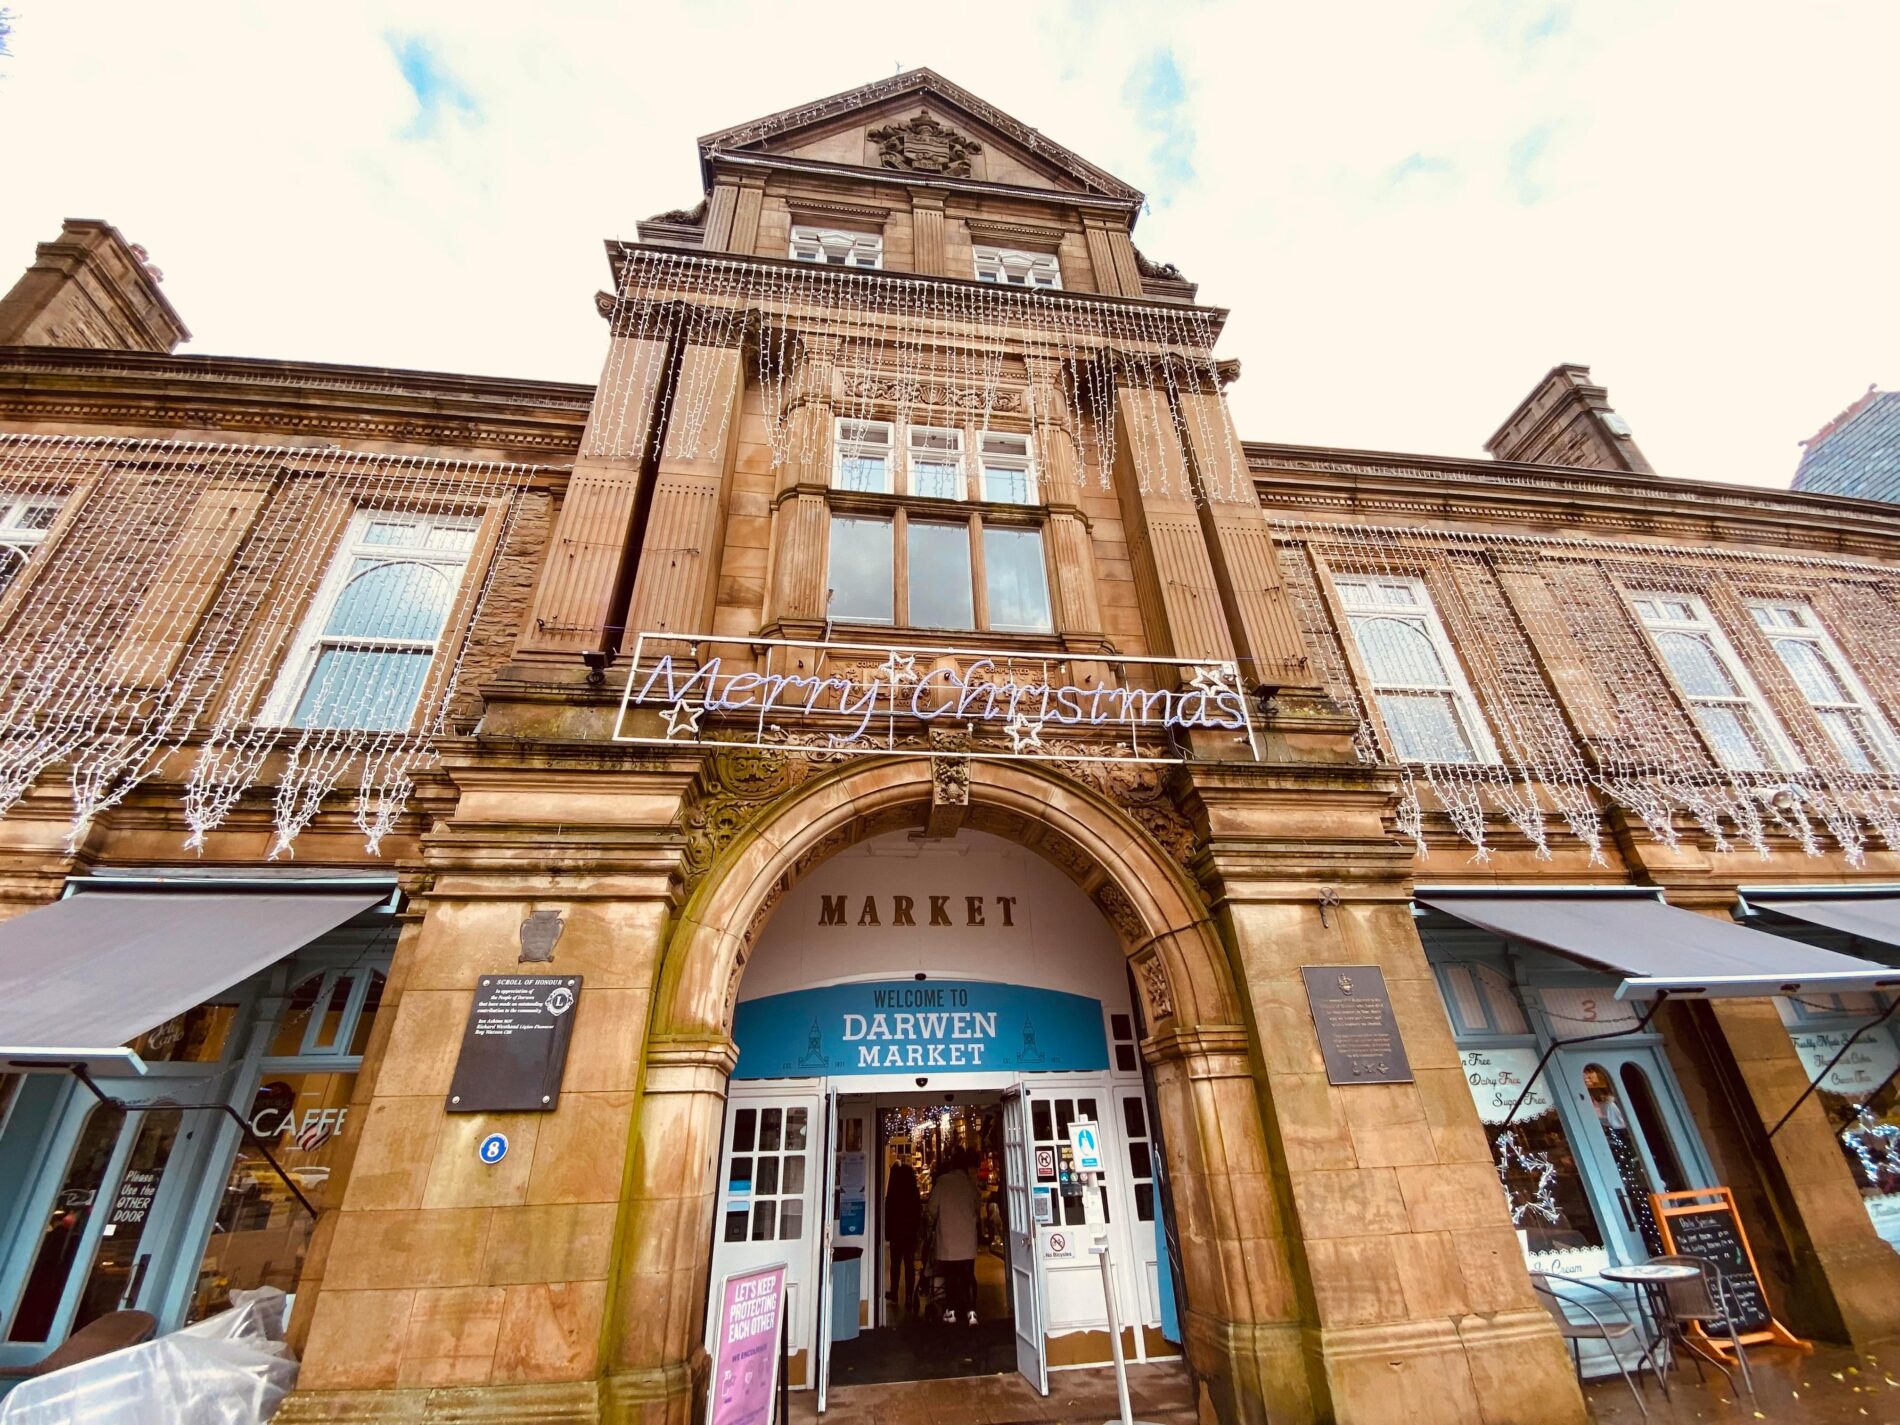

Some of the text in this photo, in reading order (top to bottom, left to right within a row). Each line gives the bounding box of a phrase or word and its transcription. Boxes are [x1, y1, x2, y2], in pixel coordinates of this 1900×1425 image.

[632, 655, 1246, 743] Merry Christmas
[818, 895, 1017, 927] MARKET
[873, 989, 968, 1009] WELCOME TO
[1582, 1000, 1597, 1022] 3
[842, 1012, 997, 1041] DARWEN
[857, 1044, 985, 1068] MARKET
[1468, 1052, 1491, 1066] Free
[1469, 1071, 1521, 1089] Dairy Free
[1524, 1091, 1546, 1105] Free
[487, 1141, 499, 1157] 8
[125, 1170, 154, 1182] Please
[121, 1183, 155, 1196] Use the
[117, 1196, 151, 1209] OTHER
[113, 1210, 145, 1222] DOOR
[1053, 1251, 1072, 1259] Bicycles
[1552, 1258, 1582, 1275] Cream
[735, 1276, 776, 1303] LET'S KEEP
[729, 1293, 777, 1324] PROTECTING
[728, 1311, 775, 1344] EACH OTHER
